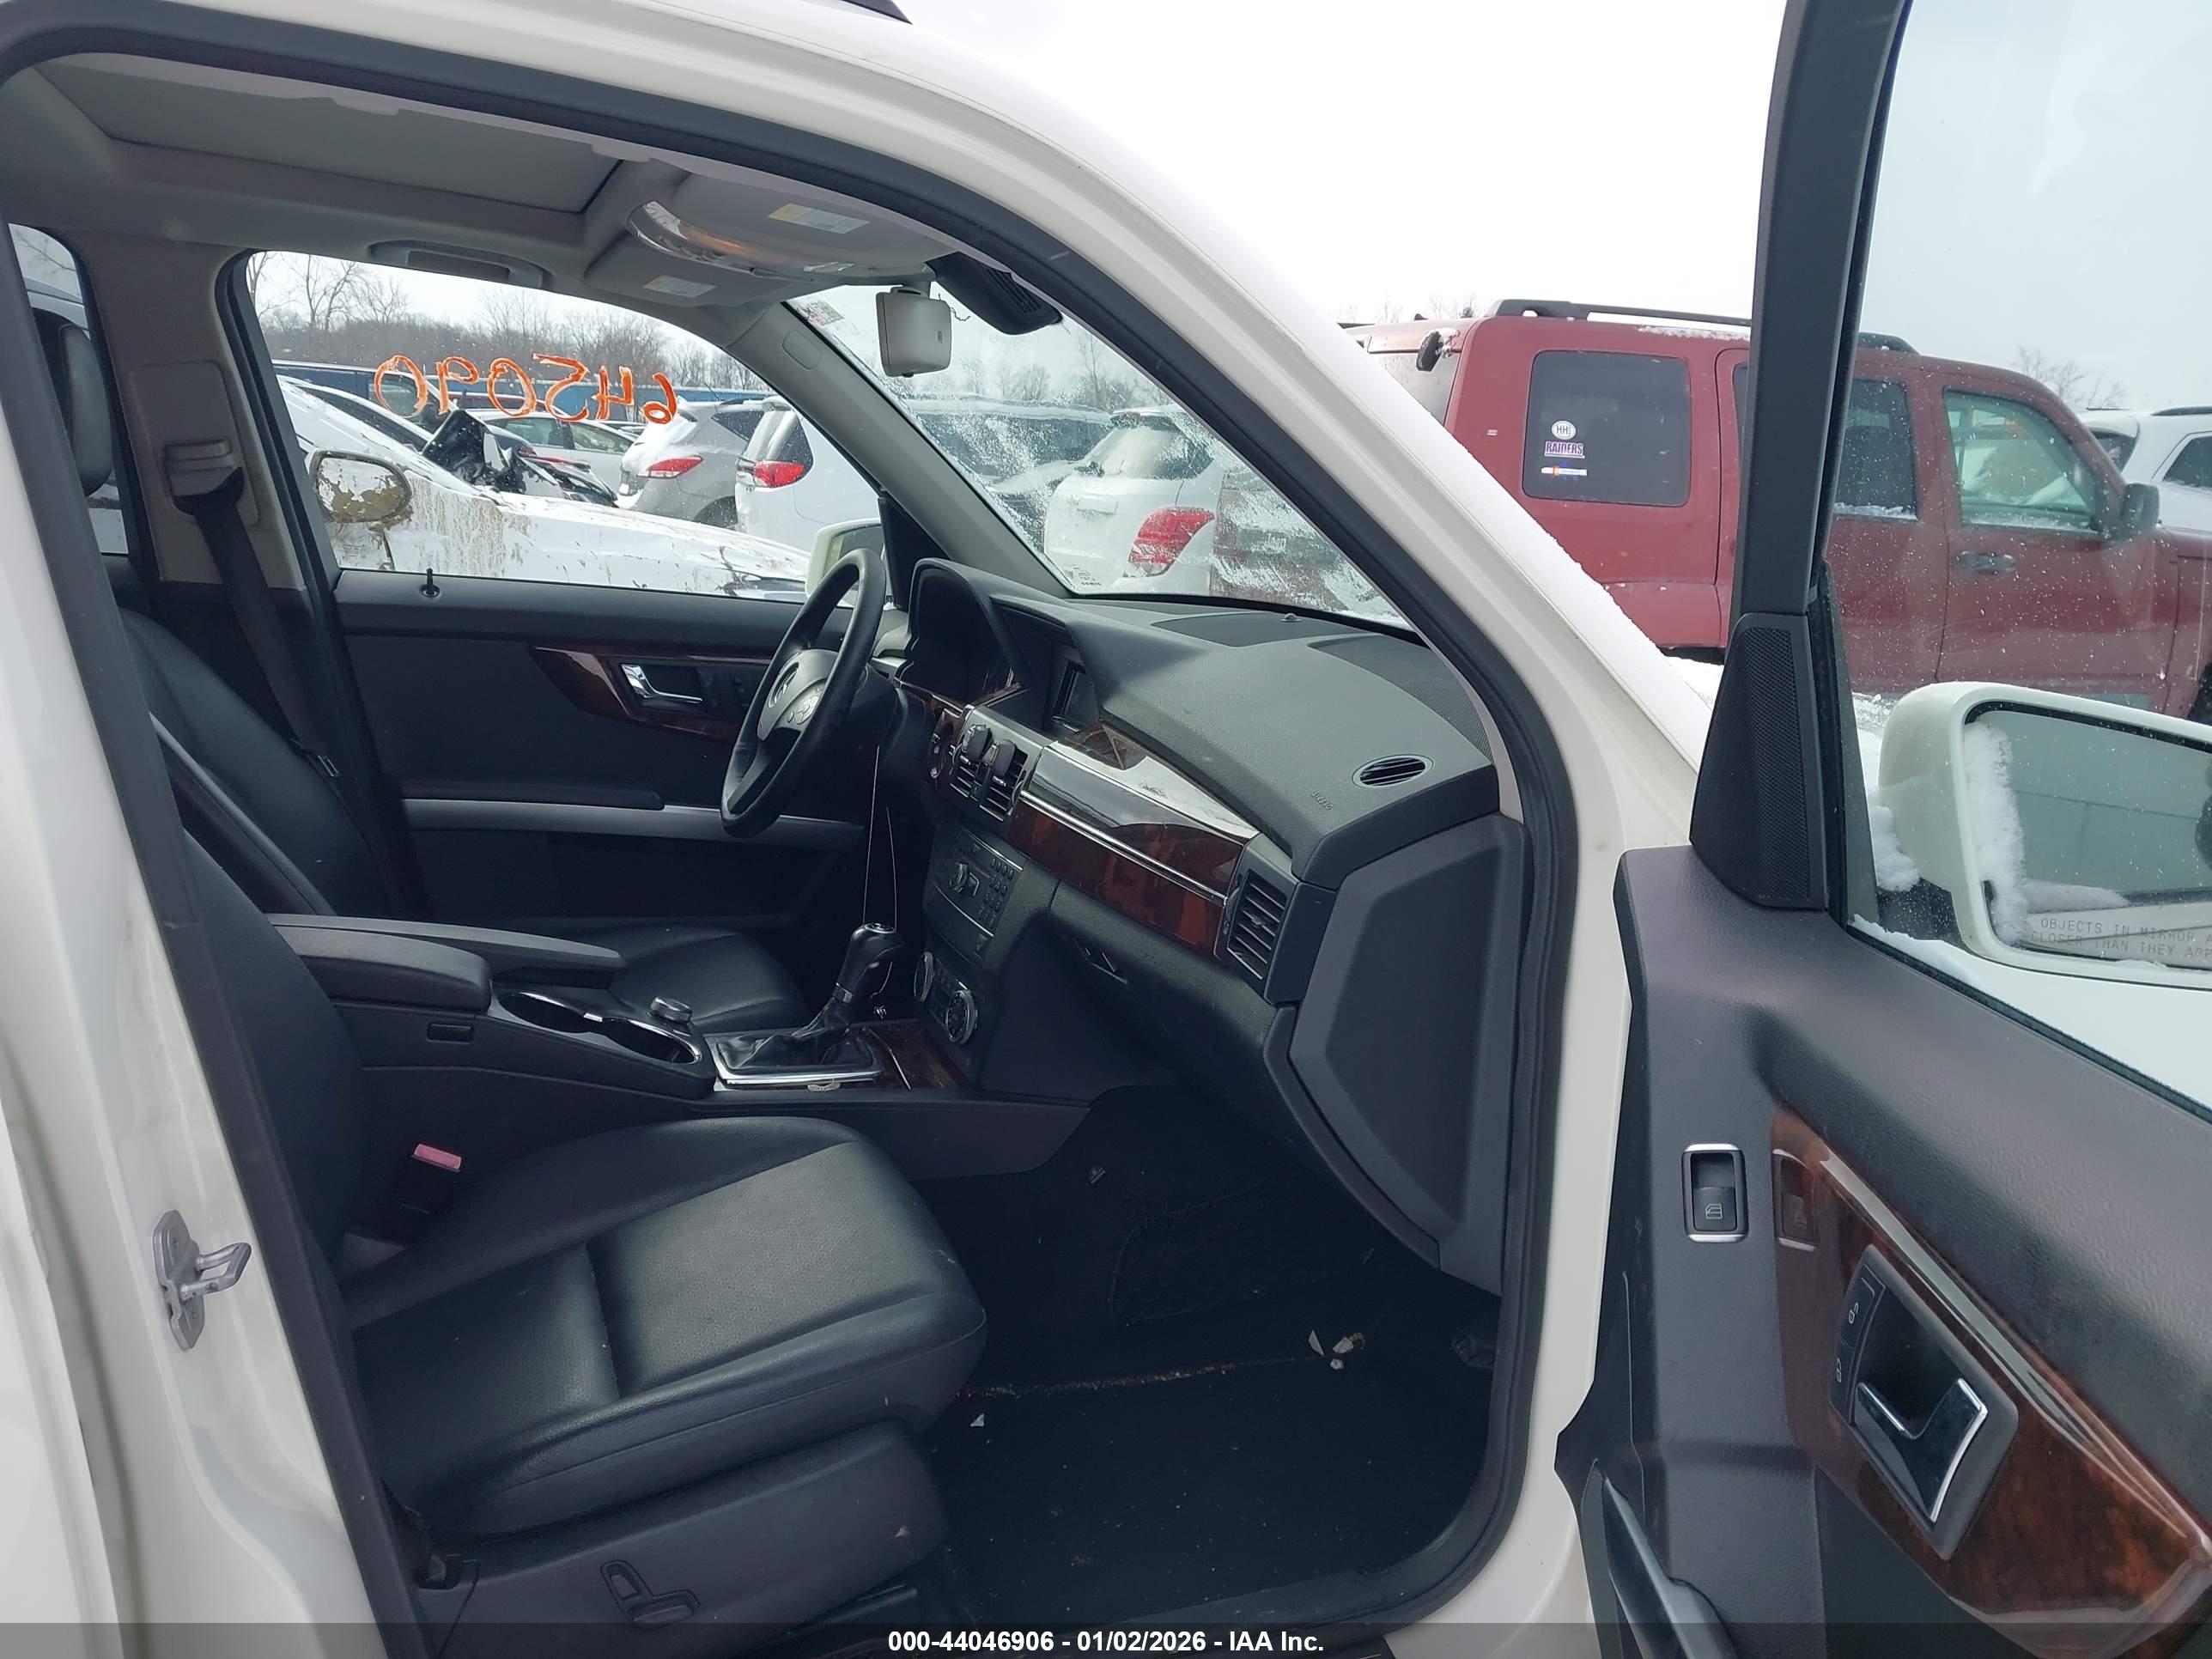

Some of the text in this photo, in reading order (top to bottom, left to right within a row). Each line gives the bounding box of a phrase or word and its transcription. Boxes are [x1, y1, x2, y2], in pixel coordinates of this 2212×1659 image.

[1546, 441, 1584, 455] RAIDERS
[2040, 917, 2103, 934] OBJECTS
[2113, 924, 2130, 936] IN
[2139, 927, 2196, 943] MIRROR
[2030, 931, 2082, 947] CLOSER
[2094, 937, 2129, 951] THAN
[2139, 940, 2176, 956] THEY
